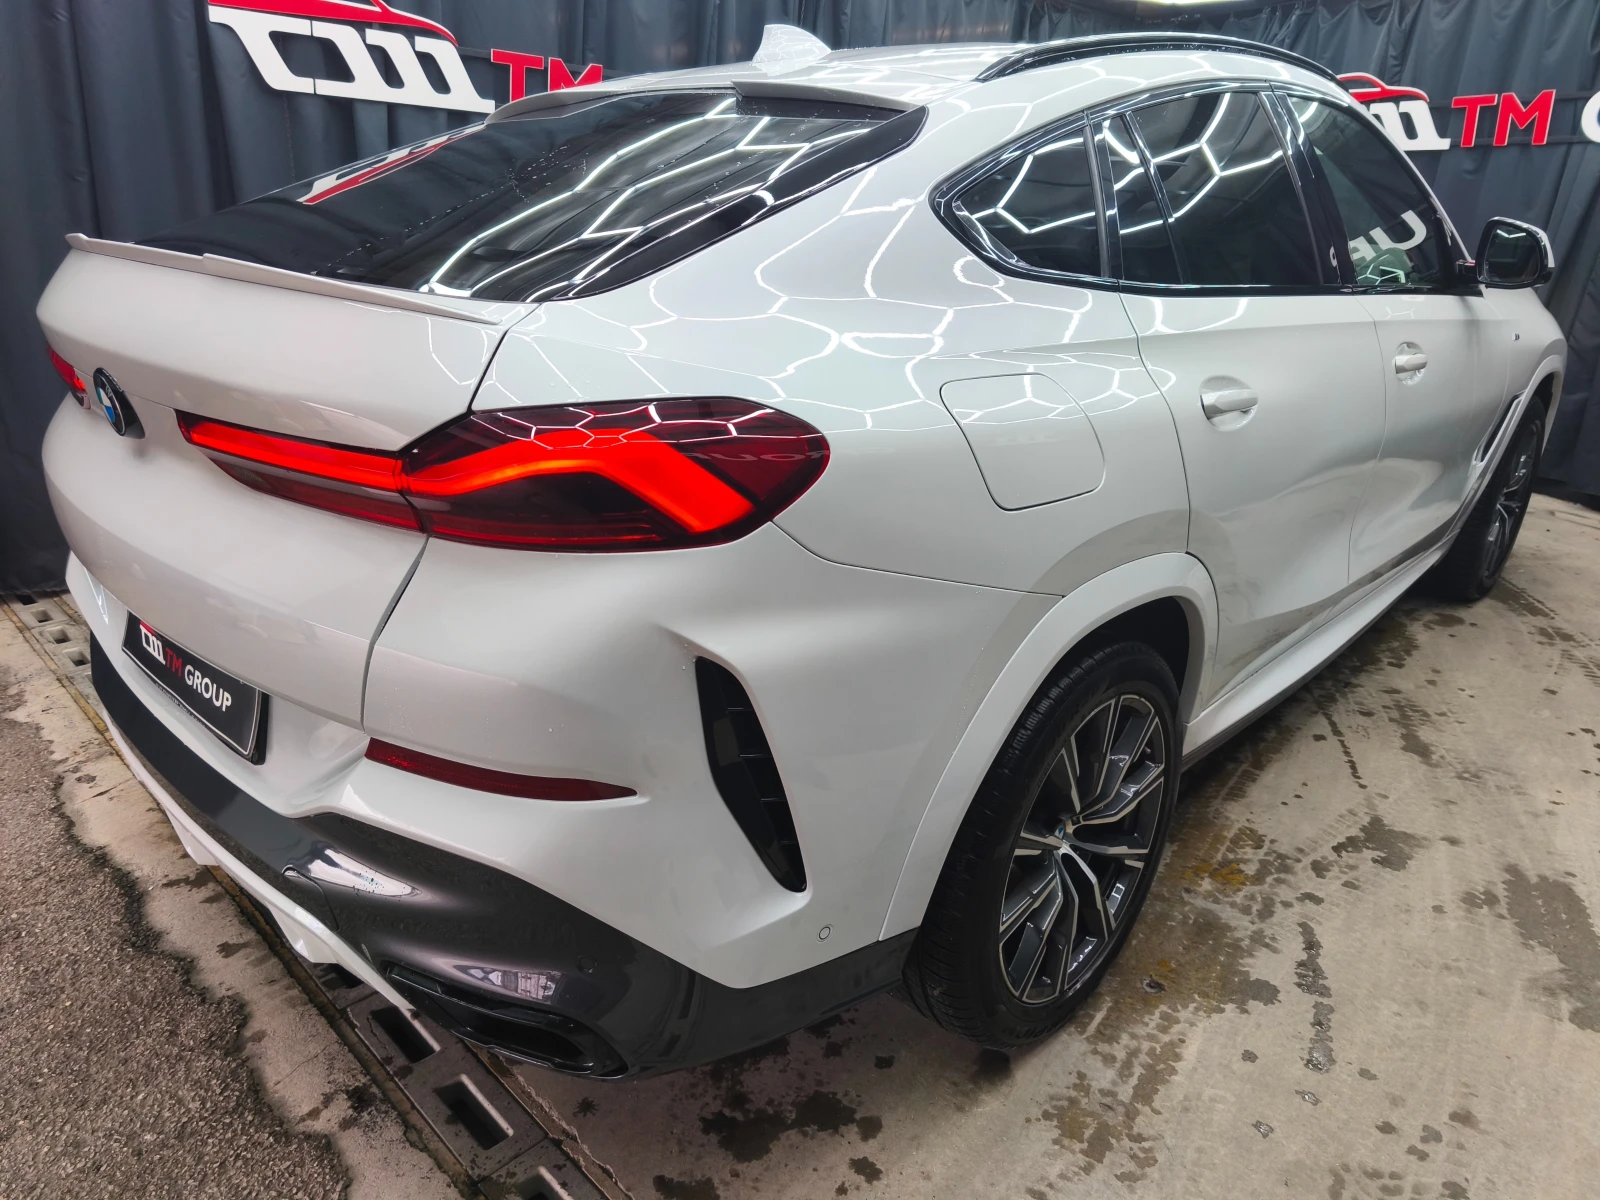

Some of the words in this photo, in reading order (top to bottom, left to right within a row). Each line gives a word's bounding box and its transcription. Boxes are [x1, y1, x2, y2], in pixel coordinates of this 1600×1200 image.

[1452, 89, 1556, 147] TM
[165, 648, 183, 677] TM
[184, 664, 232, 712] GROUP
